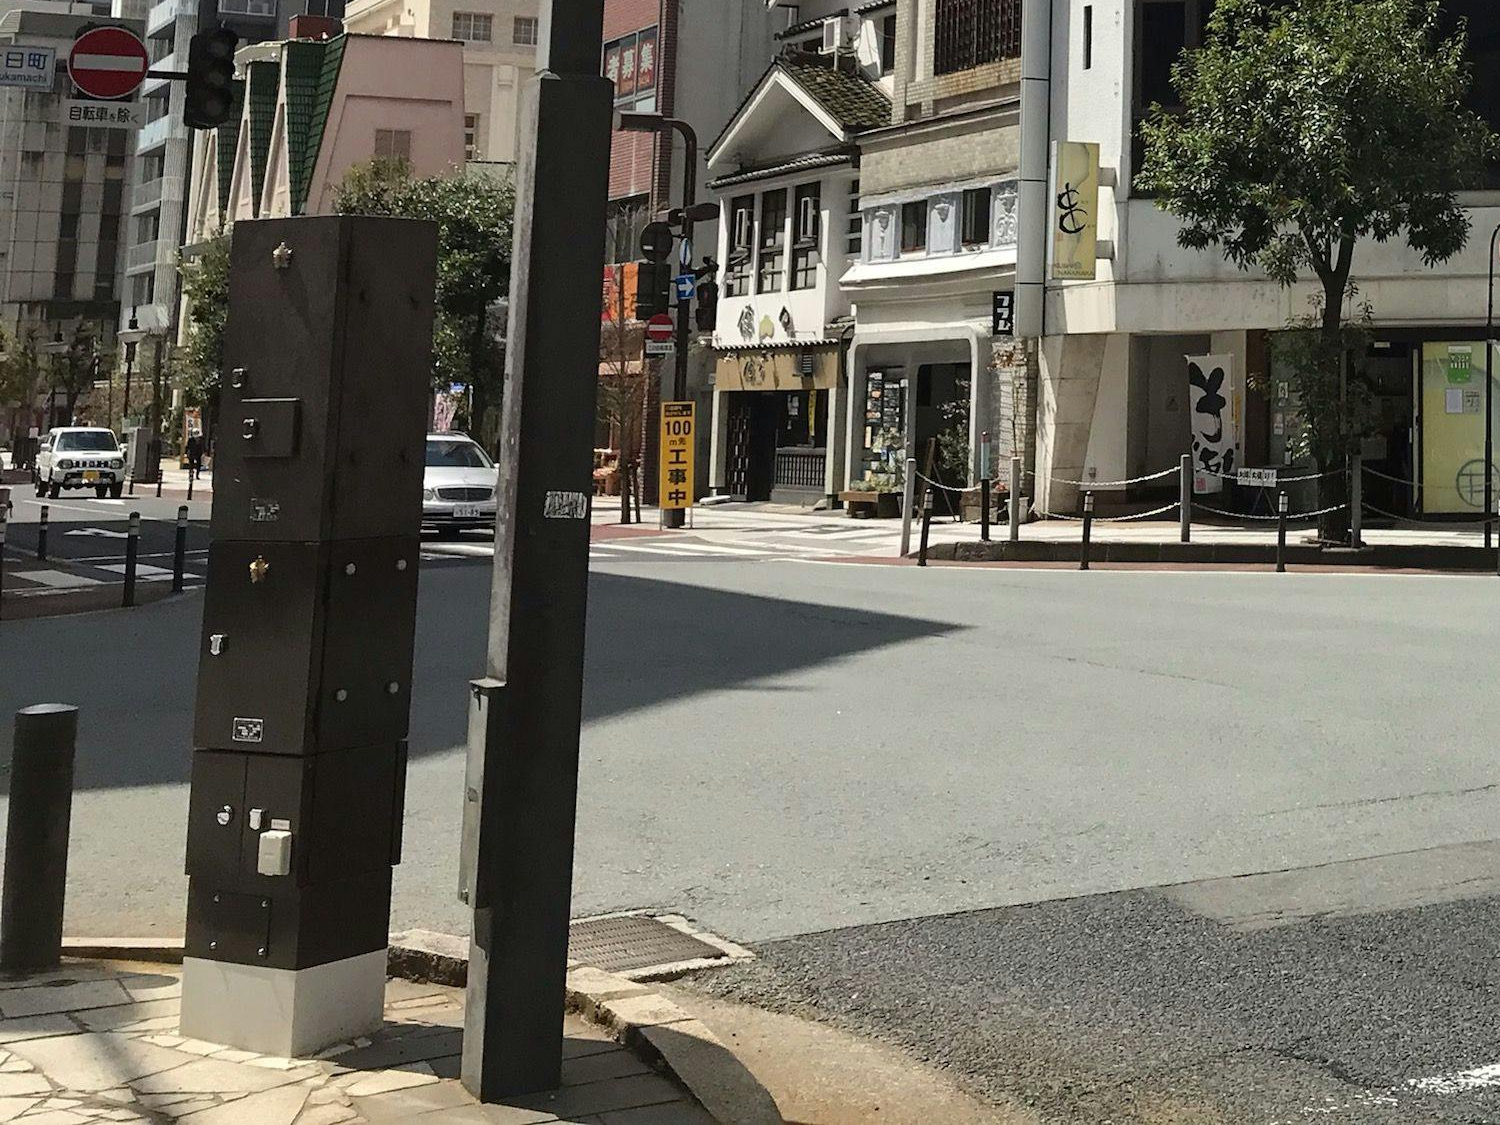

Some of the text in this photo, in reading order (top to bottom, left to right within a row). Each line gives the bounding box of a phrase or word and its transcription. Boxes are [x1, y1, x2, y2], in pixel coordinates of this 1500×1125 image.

[0, 52, 48, 70] 日町
[69, 106, 139, 124] 自転車を除く
[665, 420, 691, 436] 100
[668, 449, 688, 506] 工事中
